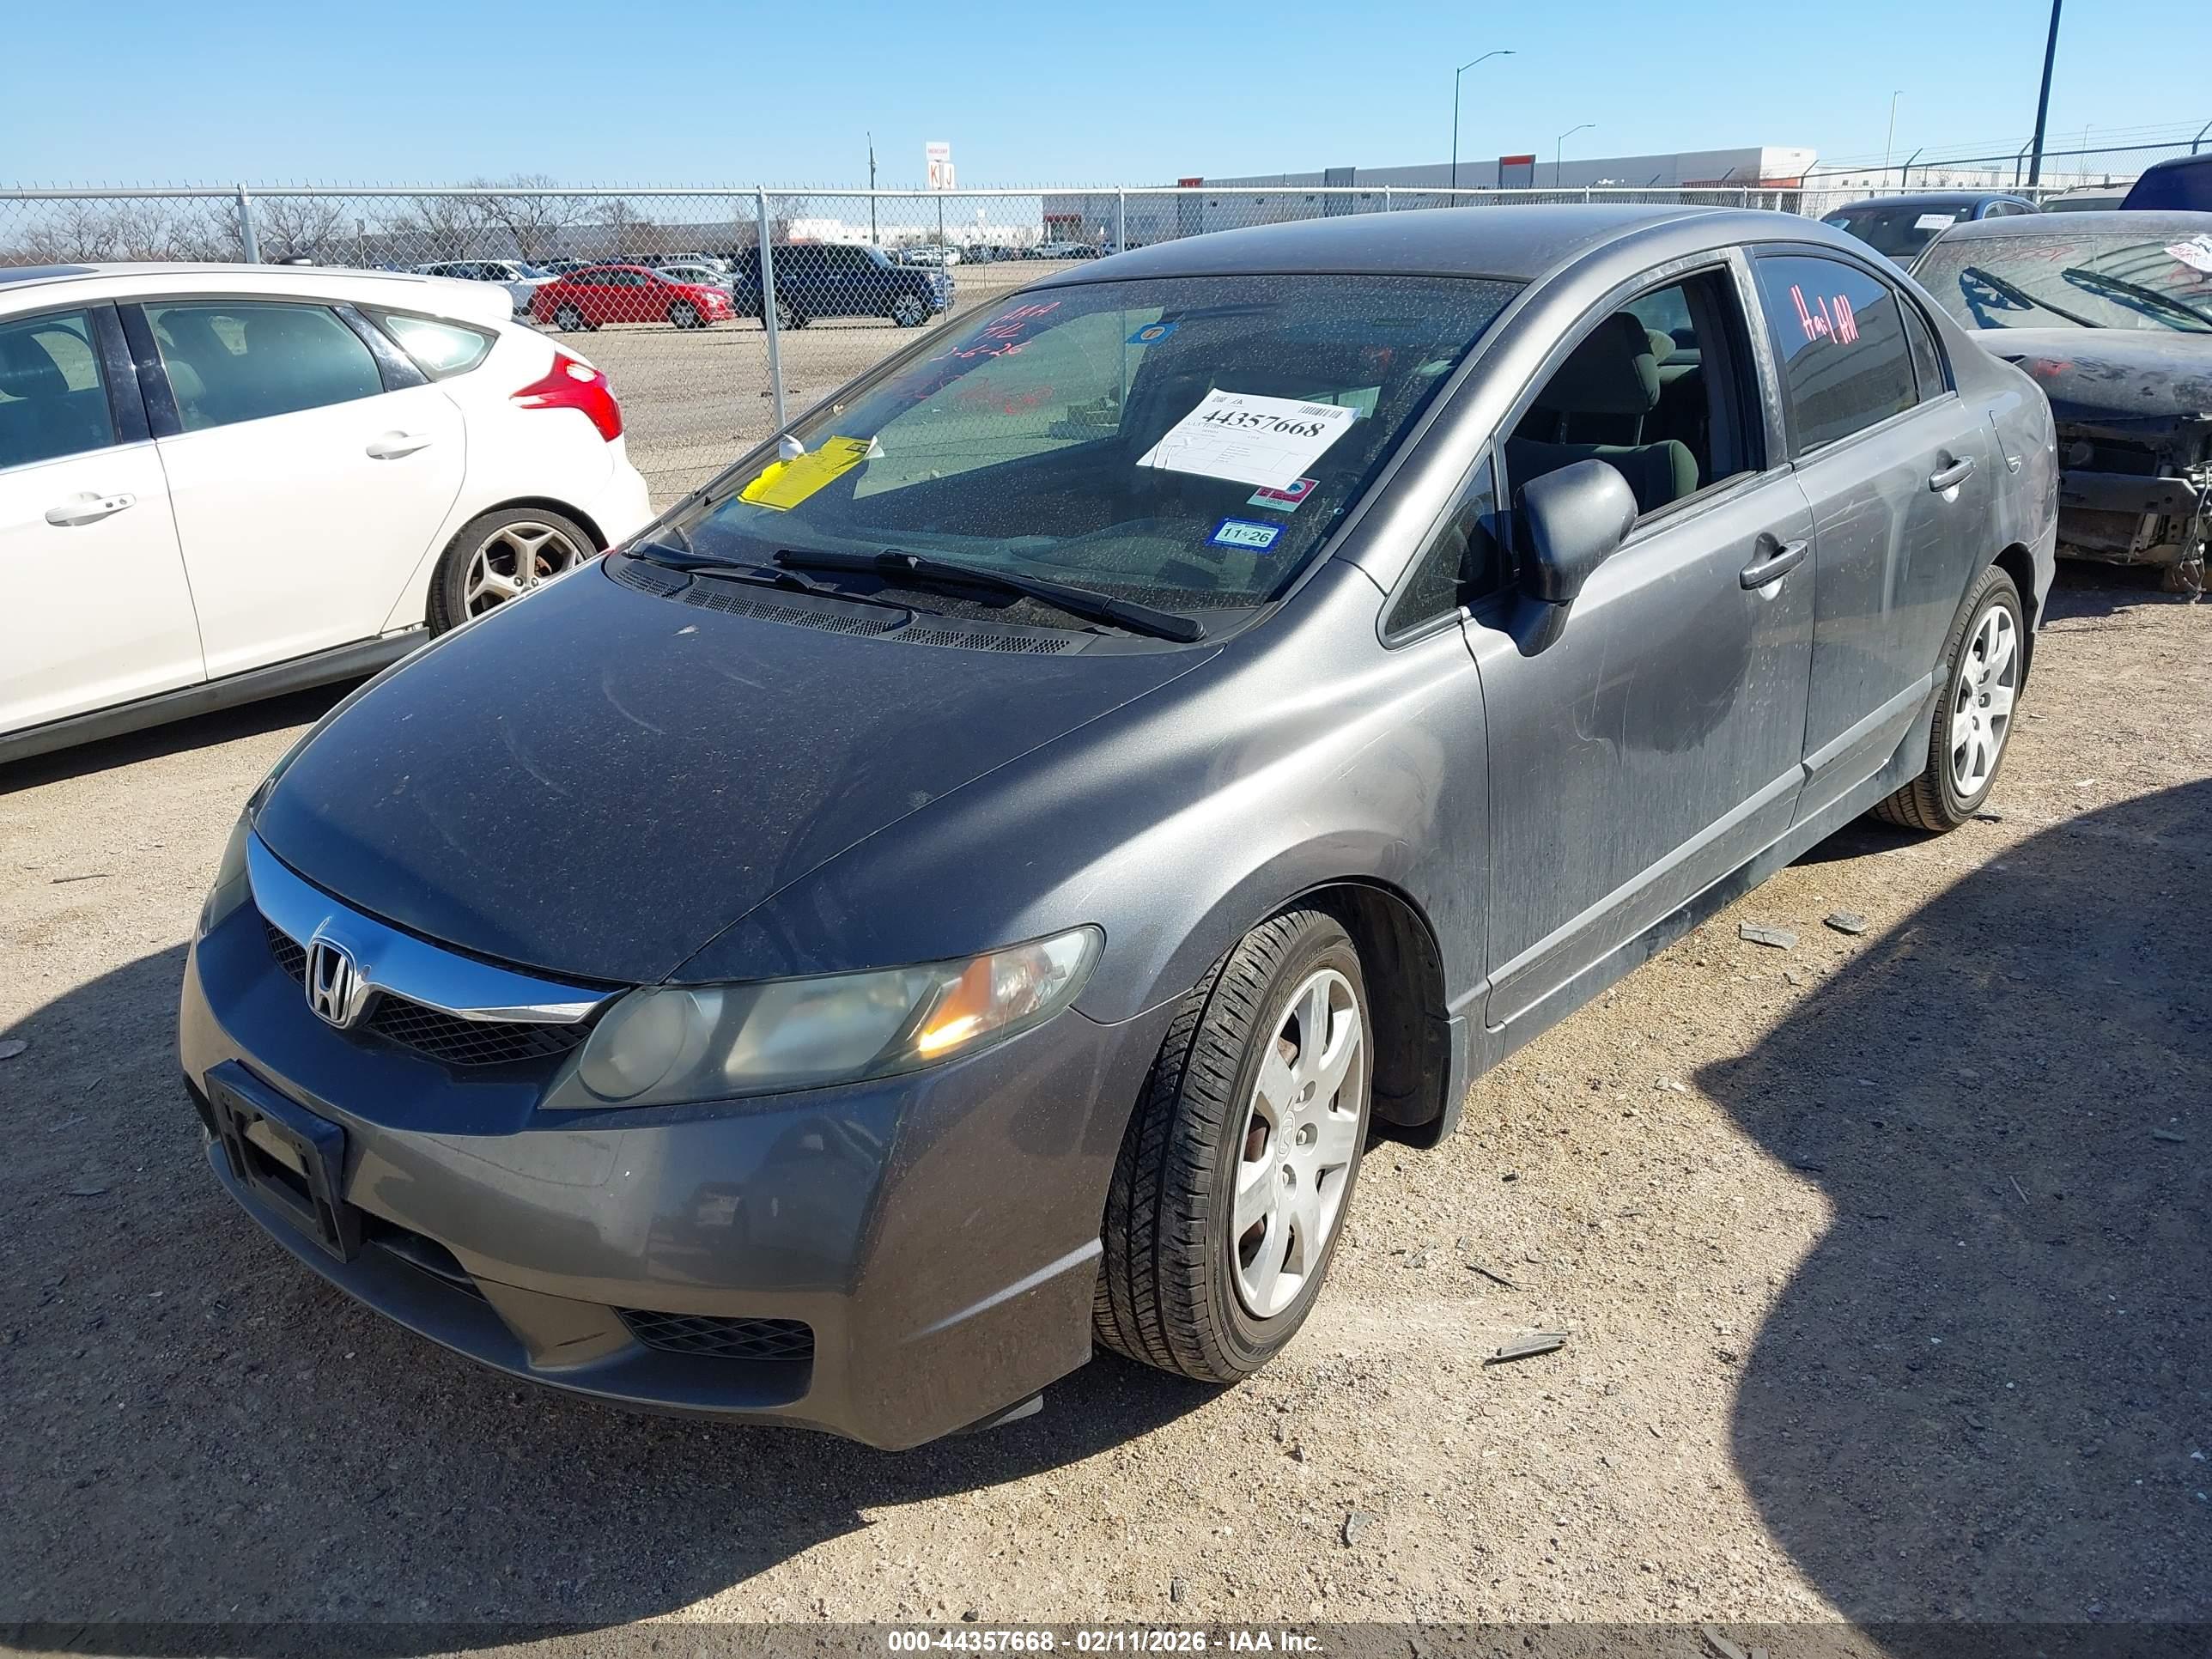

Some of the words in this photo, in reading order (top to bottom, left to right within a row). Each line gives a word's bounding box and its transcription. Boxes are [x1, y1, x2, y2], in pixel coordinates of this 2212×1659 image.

[1202, 409, 1326, 438] 44357668
[1223, 527, 1243, 538] 11
[1249, 531, 1272, 543] 26
